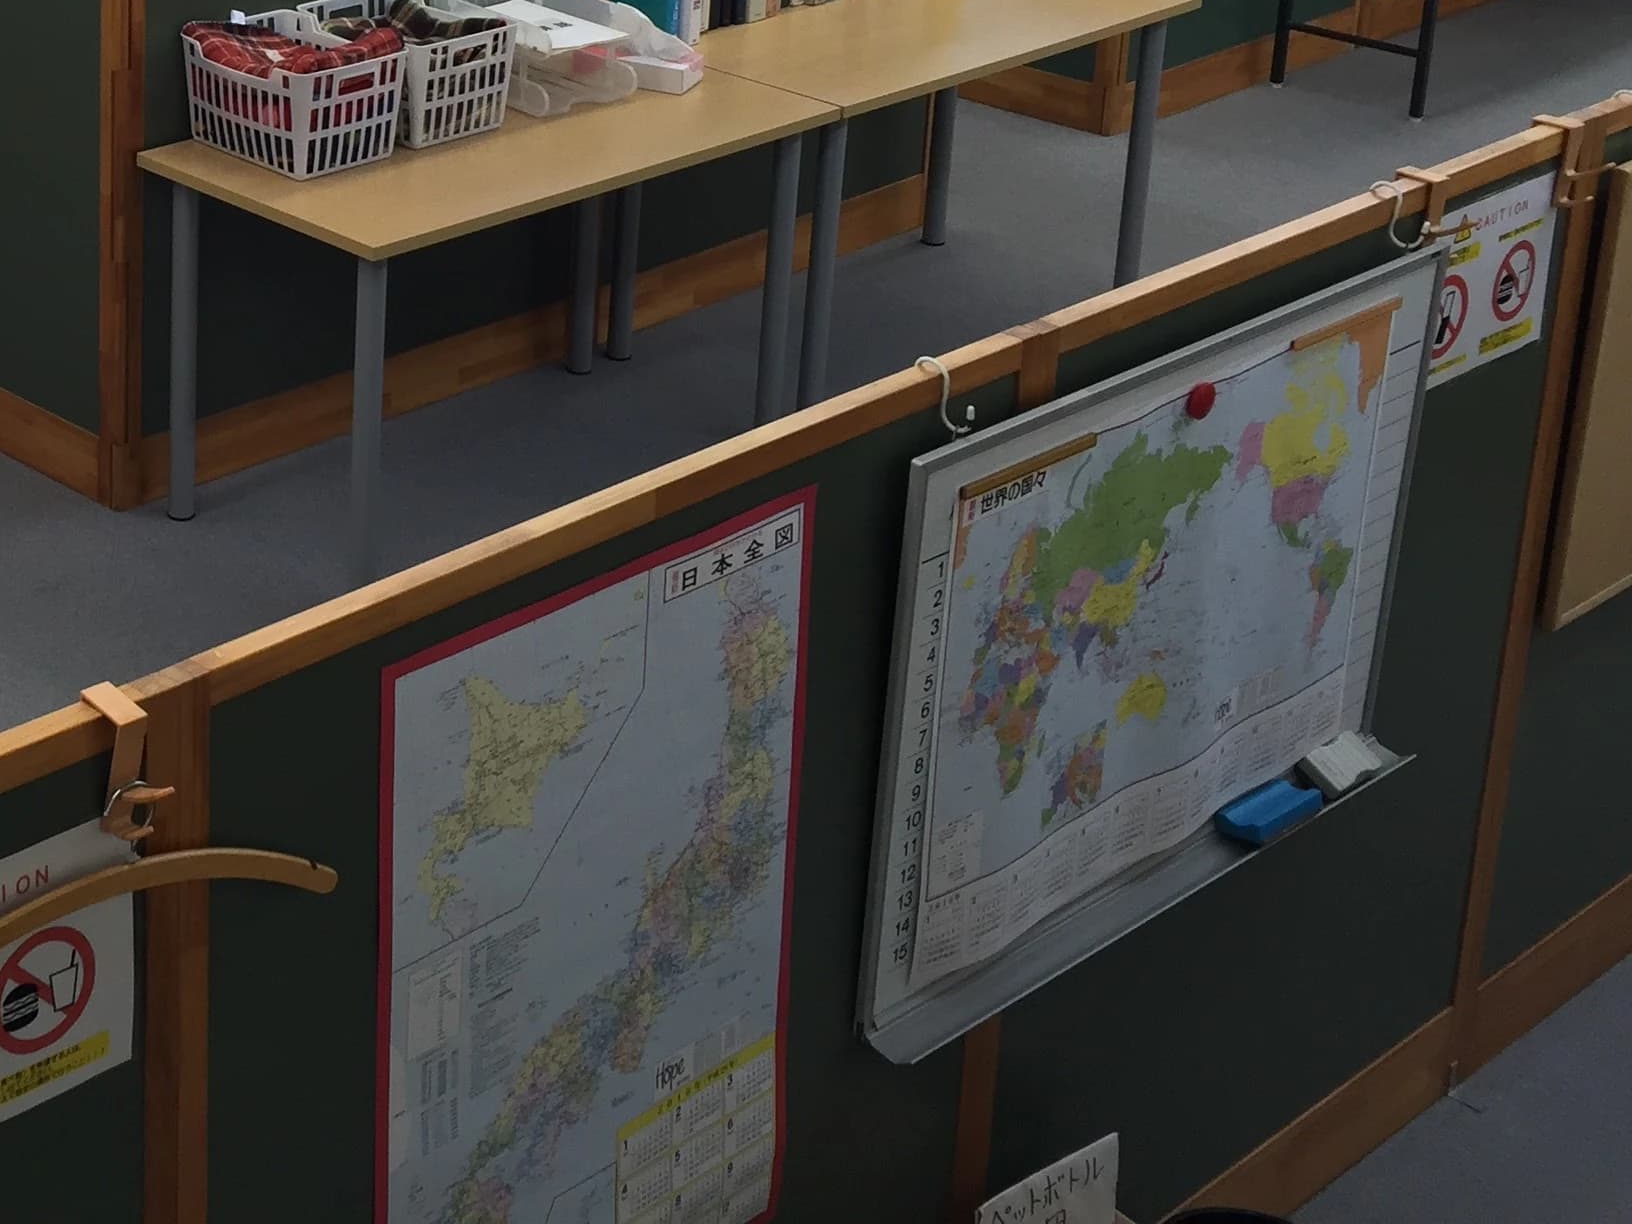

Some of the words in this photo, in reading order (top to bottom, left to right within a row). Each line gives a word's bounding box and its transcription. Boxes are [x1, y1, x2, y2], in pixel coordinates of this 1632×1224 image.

[980, 470, 1047, 515] 世界の国々
[681, 522, 794, 591] 日本全図
[938, 561, 945, 575] 1
[933, 589, 943, 608] 2
[930, 617, 940, 636] 3
[926, 646, 936, 663] 4
[923, 674, 934, 692] 5
[920, 701, 930, 718] 6
[919, 729, 928, 747] 7
[914, 757, 924, 775] 8
[911, 784, 921, 802] 9
[905, 811, 922, 831] 10
[903, 838, 917, 856] 11
[900, 864, 916, 884] 12
[897, 890, 913, 911] 13
[895, 917, 910, 937] 14
[893, 942, 908, 963] 15
[992, 1156, 1105, 1224] ペットボトル
